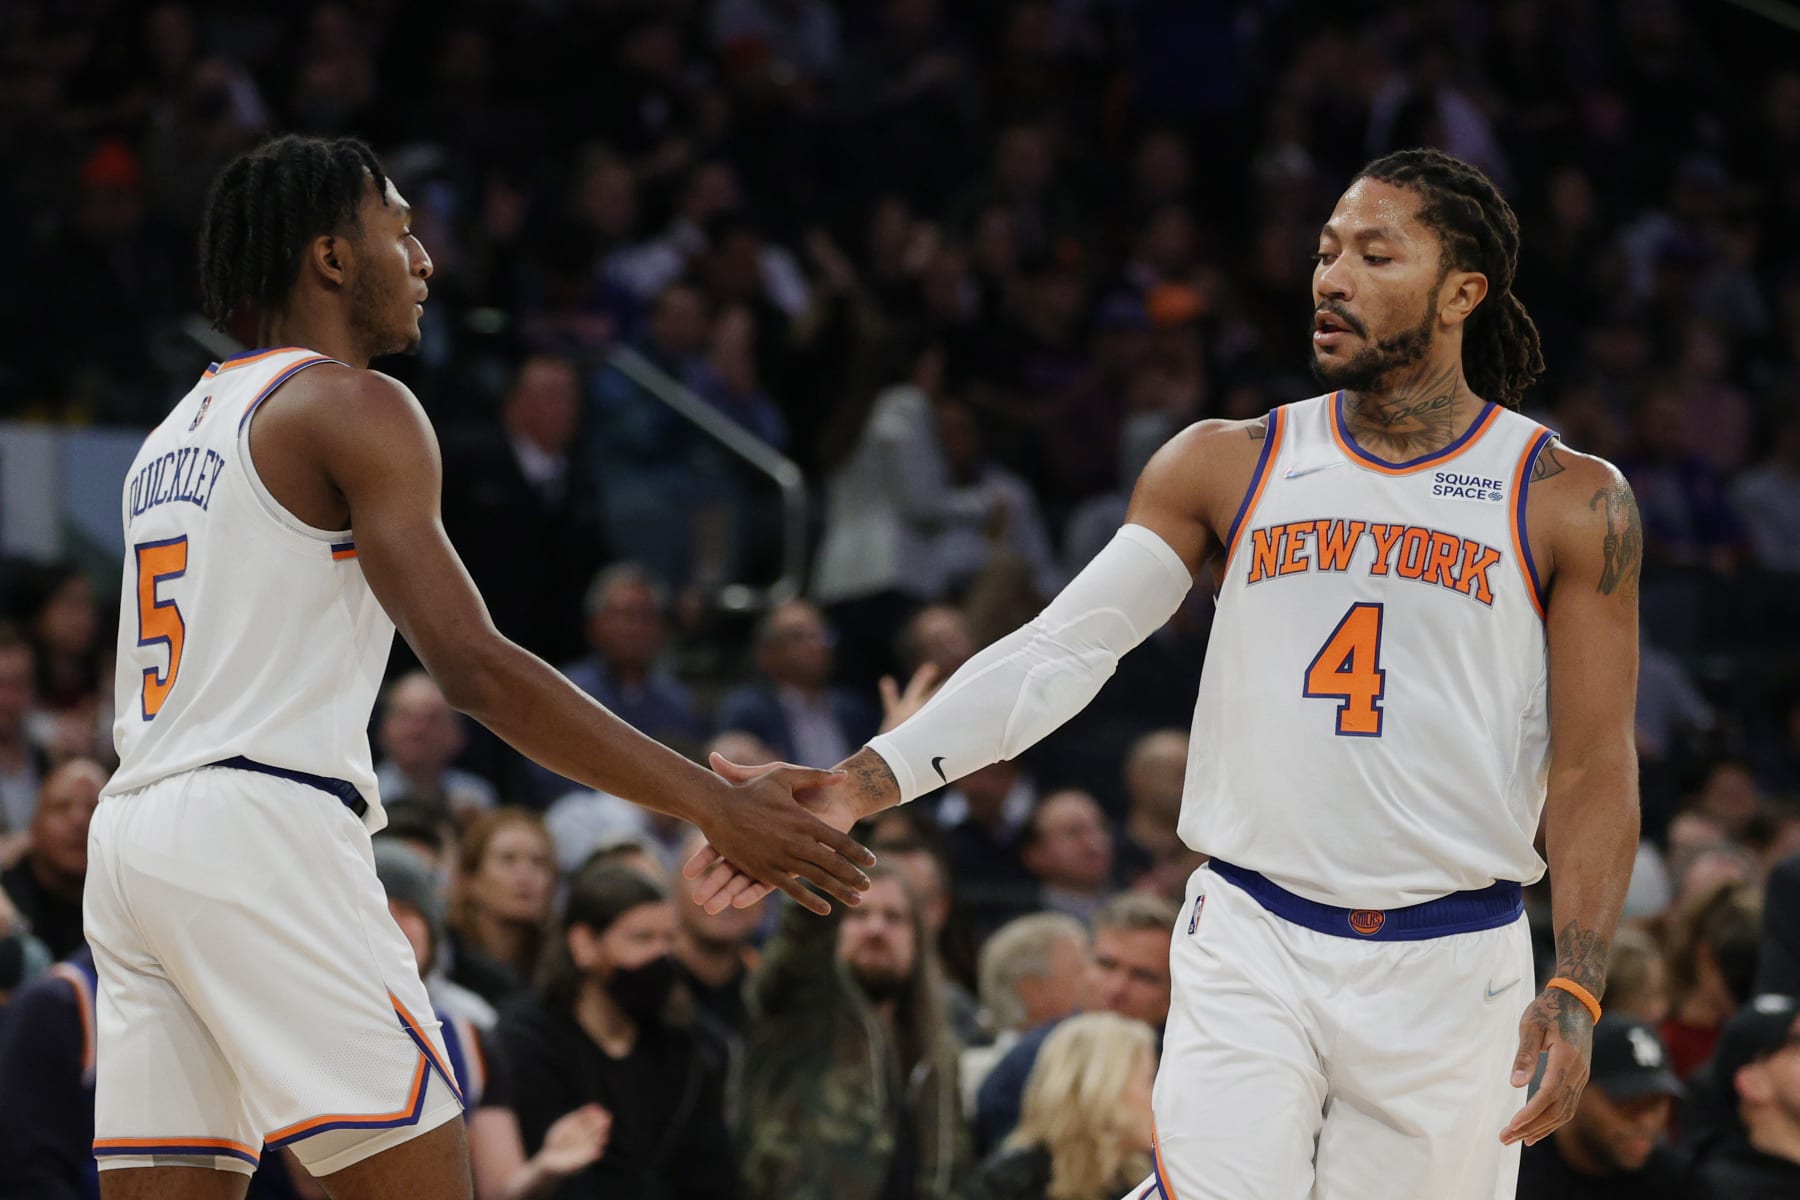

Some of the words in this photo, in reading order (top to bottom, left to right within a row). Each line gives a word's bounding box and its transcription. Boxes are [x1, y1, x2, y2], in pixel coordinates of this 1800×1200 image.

[128, 447, 225, 528] QUICKLEY
[1432, 484, 1487, 500] SPACE
[1434, 471, 1504, 491] SQUARE
[1247, 518, 1366, 586] NEW
[1369, 522, 1502, 607] YORK
[134, 534, 188, 721] 5
[1302, 601, 1386, 737] 4
[1353, 911, 1382, 926] KNICKS
